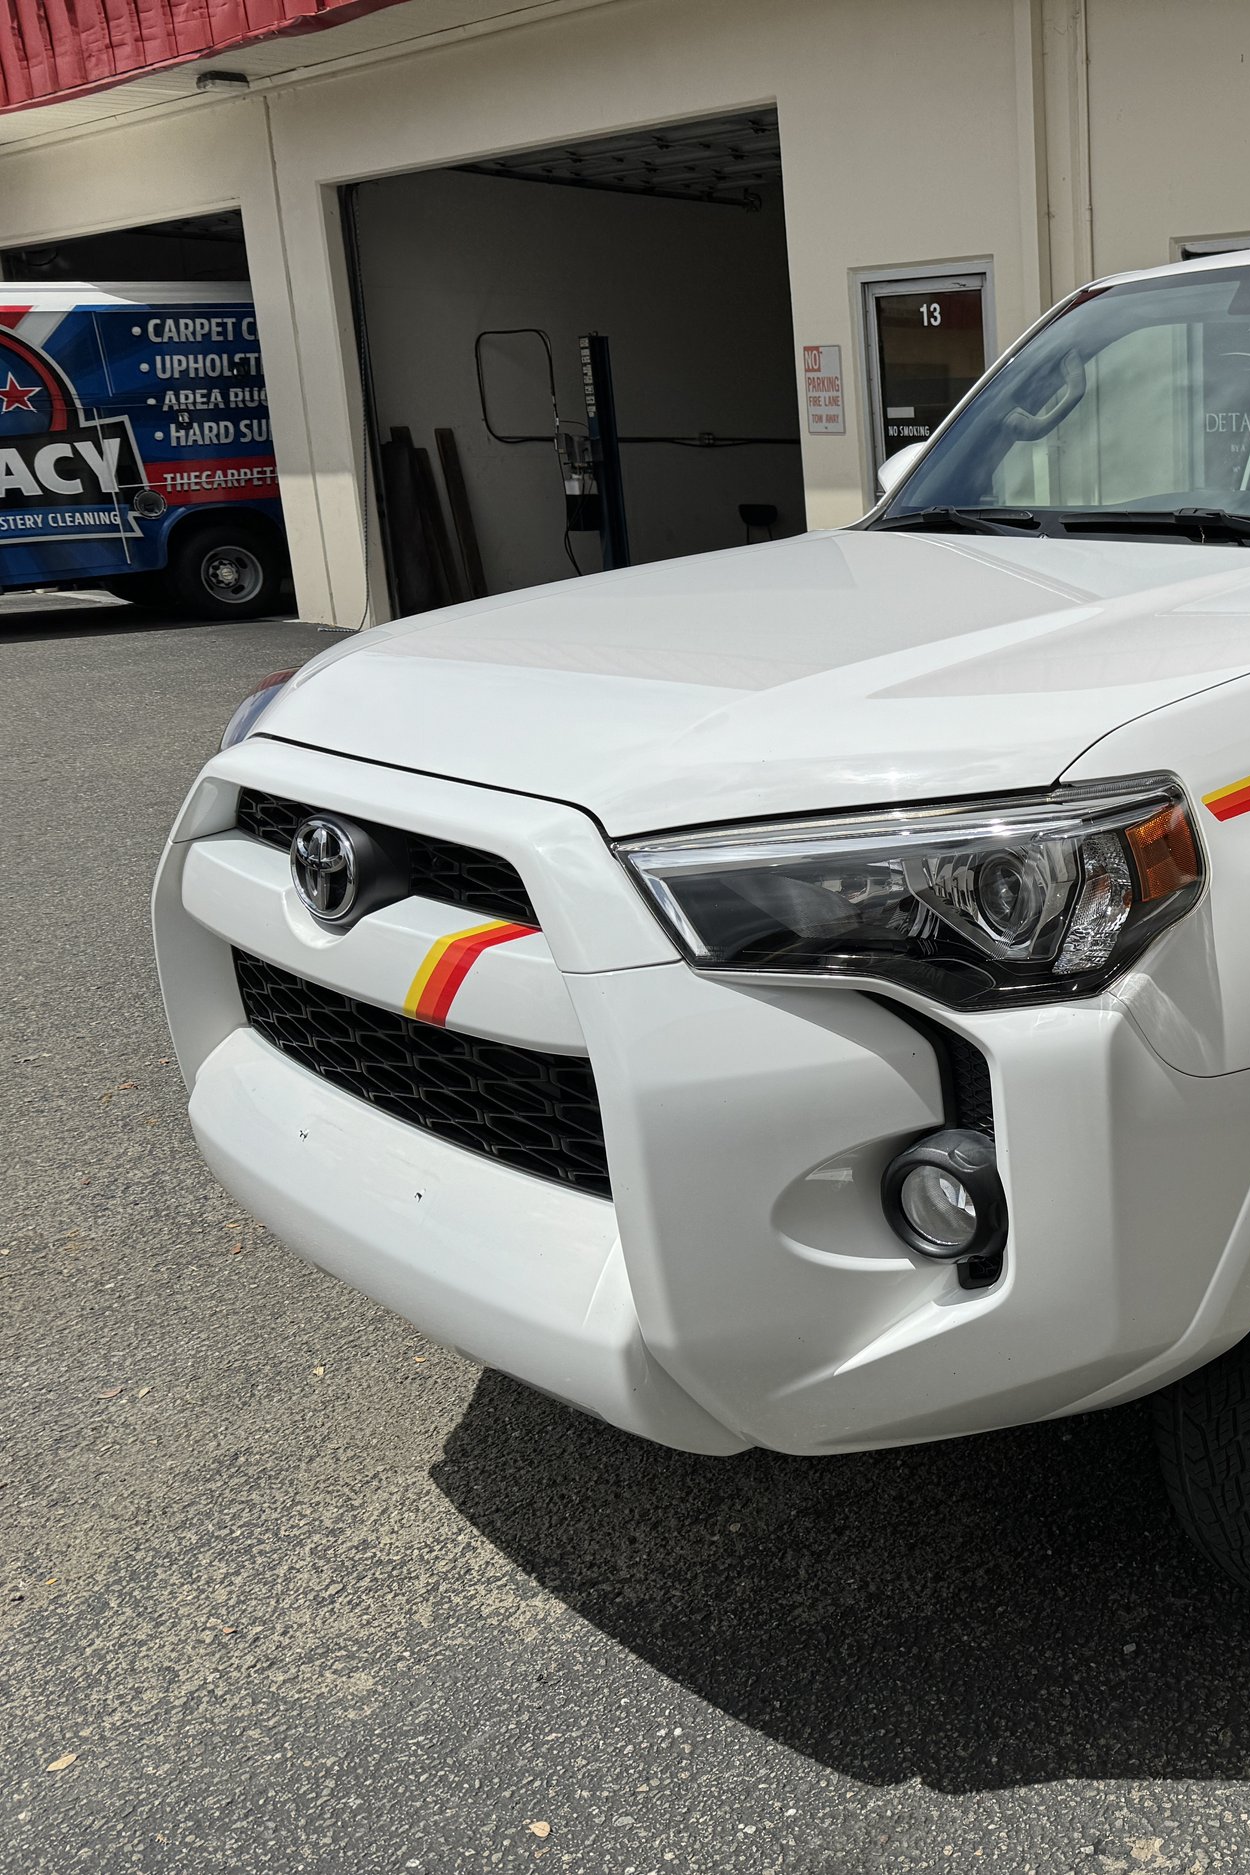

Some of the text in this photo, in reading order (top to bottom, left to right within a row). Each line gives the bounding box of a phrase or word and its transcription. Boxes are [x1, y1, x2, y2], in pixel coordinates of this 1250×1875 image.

[919, 303, 941, 327] 13
[147, 317, 237, 343] CARPET
[155, 352, 264, 380] UPHOLT
[804, 350, 819, 369] NO
[807, 376, 840, 393] PARKING
[162, 388, 225, 412] AREA
[808, 395, 840, 407] FIRE LANE
[811, 413, 839, 424] TOW AWAY
[169, 418, 273, 447] HARD SU
[888, 425, 930, 437] NO SMOKING
[0, 438, 120, 498] ACY
[0, 511, 120, 531] STERY CLEANING
